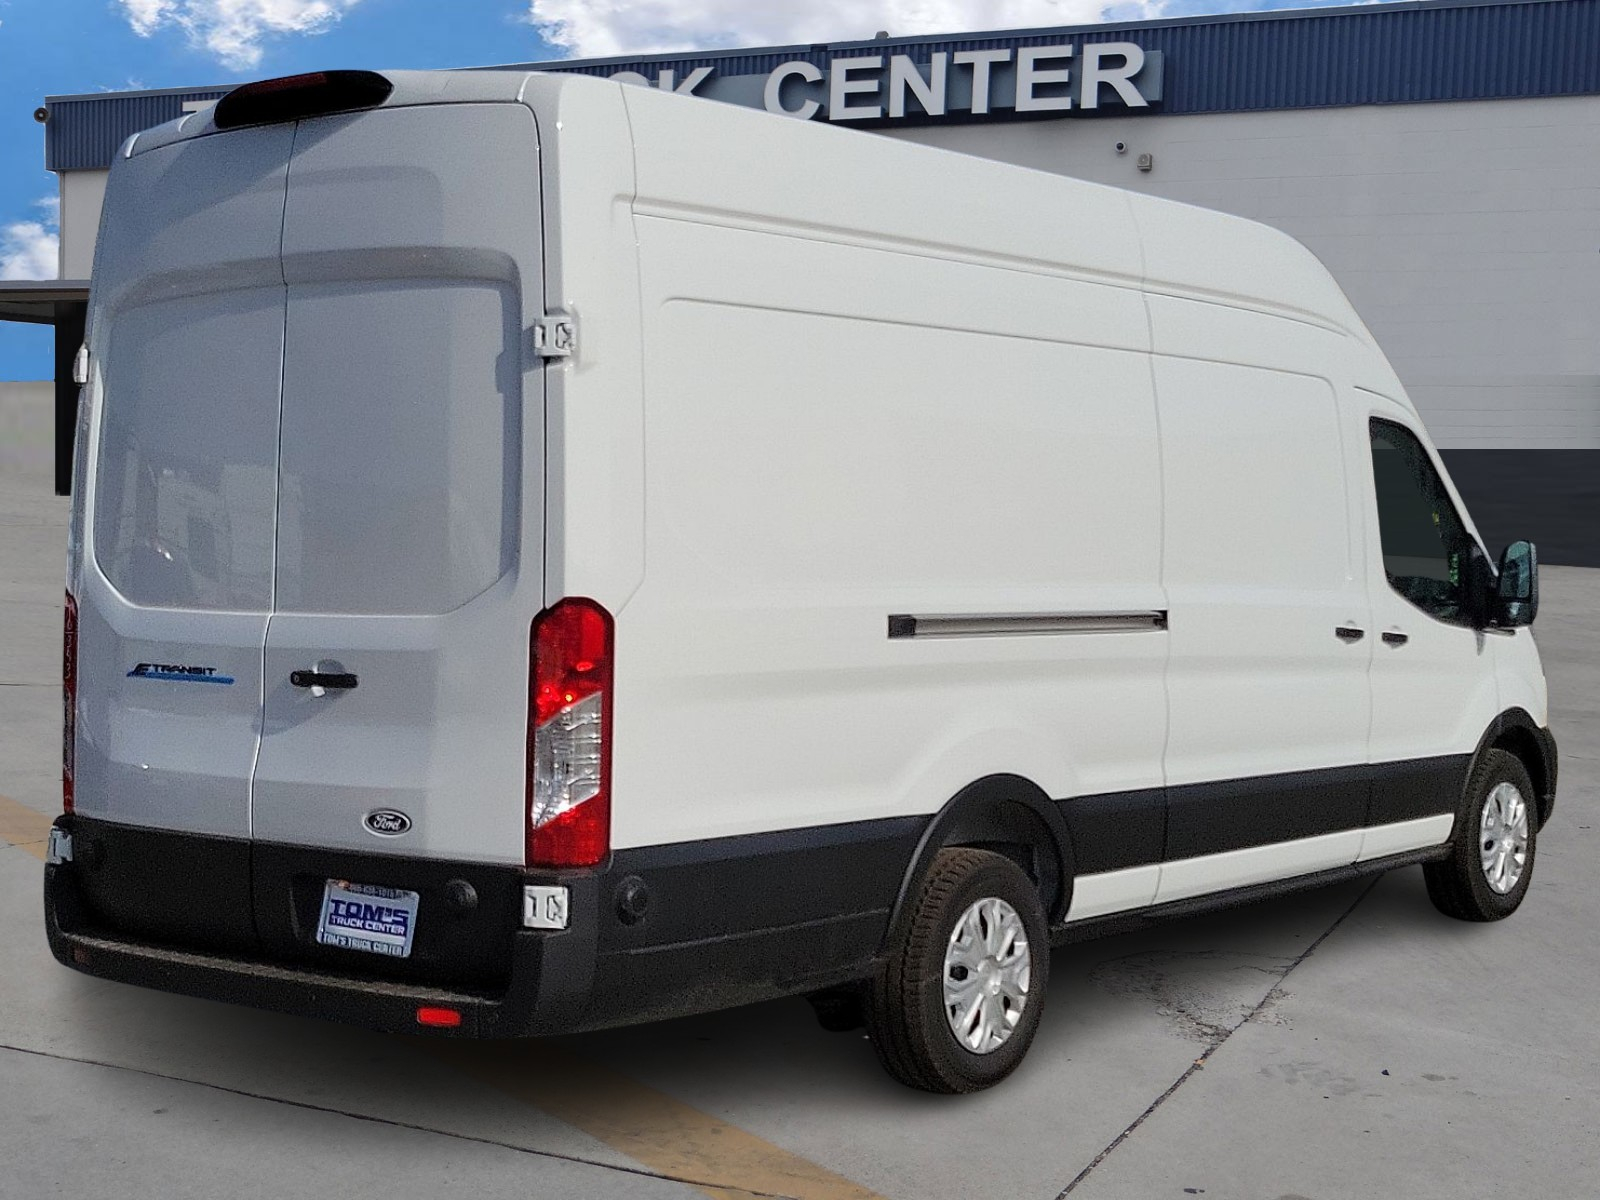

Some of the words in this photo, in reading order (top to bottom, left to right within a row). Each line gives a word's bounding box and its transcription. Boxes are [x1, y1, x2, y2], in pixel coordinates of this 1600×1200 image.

[763, 41, 1149, 121] CENTER
[374, 814, 402, 830] Ford
[330, 899, 409, 926] TOM'S
[331, 915, 364, 929] TRUCK
[365, 920, 405, 935] CENTER
